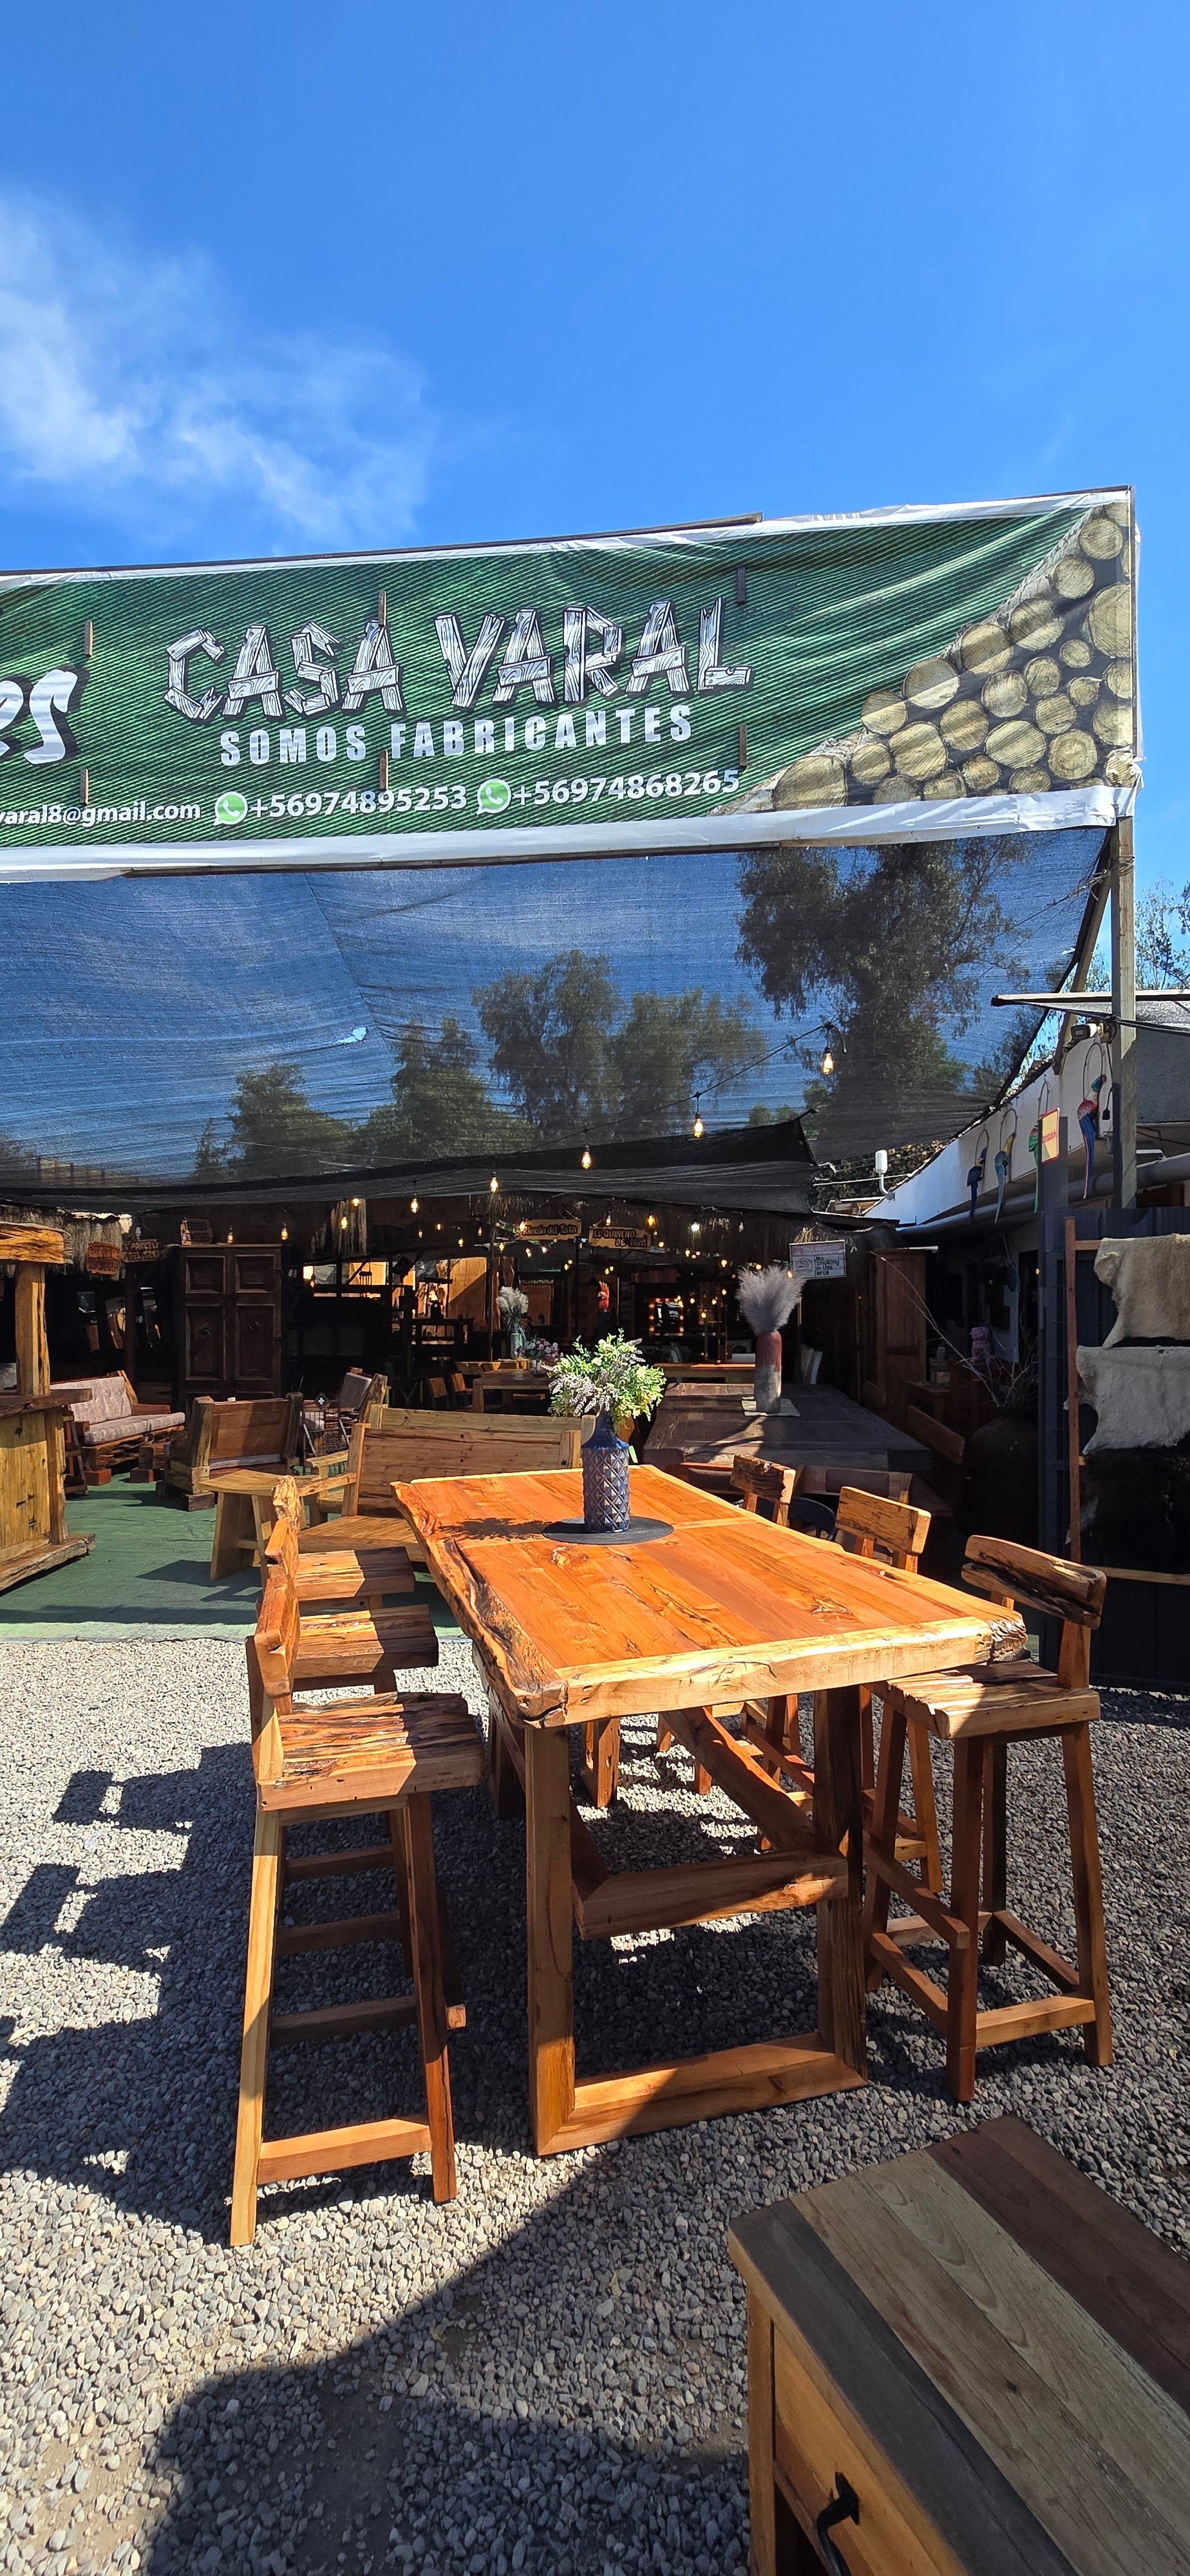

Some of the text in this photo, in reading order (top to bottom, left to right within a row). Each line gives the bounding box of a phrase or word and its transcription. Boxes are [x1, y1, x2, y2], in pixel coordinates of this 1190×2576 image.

[164, 597, 752, 719] CASA VARAL
[220, 705, 691, 766] SOMOS FABRICANTES
[251, 785, 467, 817] +56974895253
[514, 770, 740, 805] +56974868265
[547, 1226, 558, 1235] del
[560, 1224, 577, 1234] Tata
[603, 1229, 636, 1238] QUINCHO
[615, 1238, 626, 1247] DE
